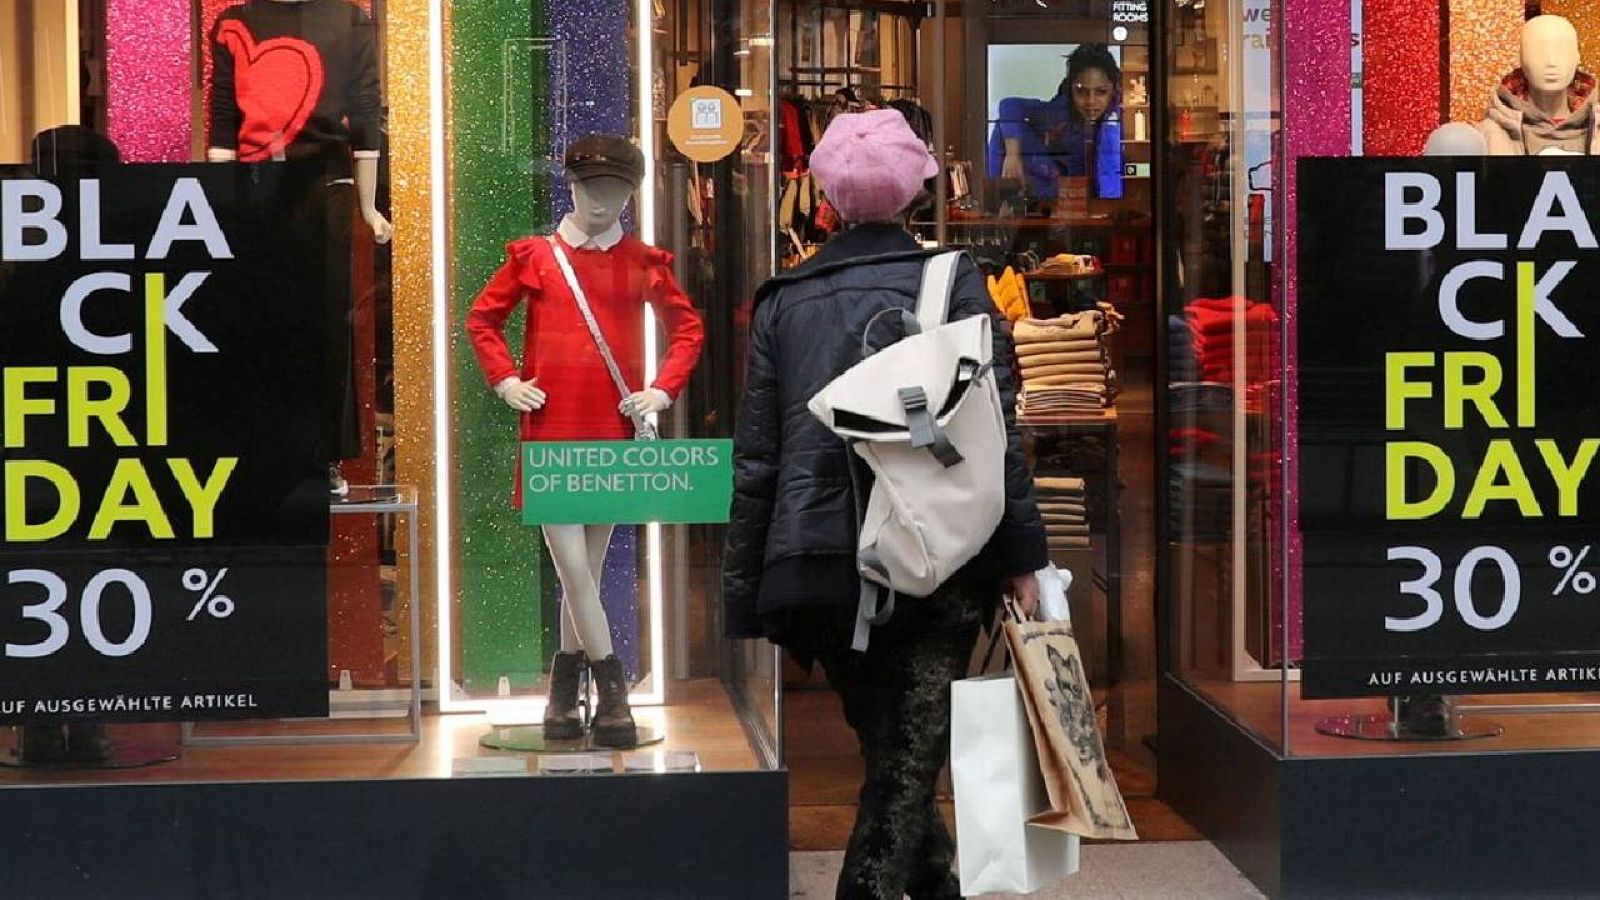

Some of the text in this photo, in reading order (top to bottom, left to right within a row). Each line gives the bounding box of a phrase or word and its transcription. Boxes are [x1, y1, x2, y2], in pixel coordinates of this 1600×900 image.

[1112, 2, 1147, 11] FITTING
[1112, 12, 1148, 22] ROOMS
[2, 178, 234, 261] BLA
[1384, 171, 1598, 250] BLA
[60, 272, 219, 354] CK
[1438, 261, 1585, 341] CK
[4, 272, 167, 447] FRI
[1385, 262, 1535, 430] FRI
[529, 446, 719, 467] UNITED COLORS
[529, 473, 694, 492] OF BENETTON.
[1385, 439, 1600, 520] DAY
[4, 457, 238, 541] DAY
[5, 567, 235, 658] 30 %
[1384, 545, 1597, 632] 30 %
[0, 694, 257, 714] UF AUSGEWÄHLTE ARTIKEL
[1369, 672, 1401, 685] AUF
[1410, 668, 1537, 684] AUSGEWÄHLTE
